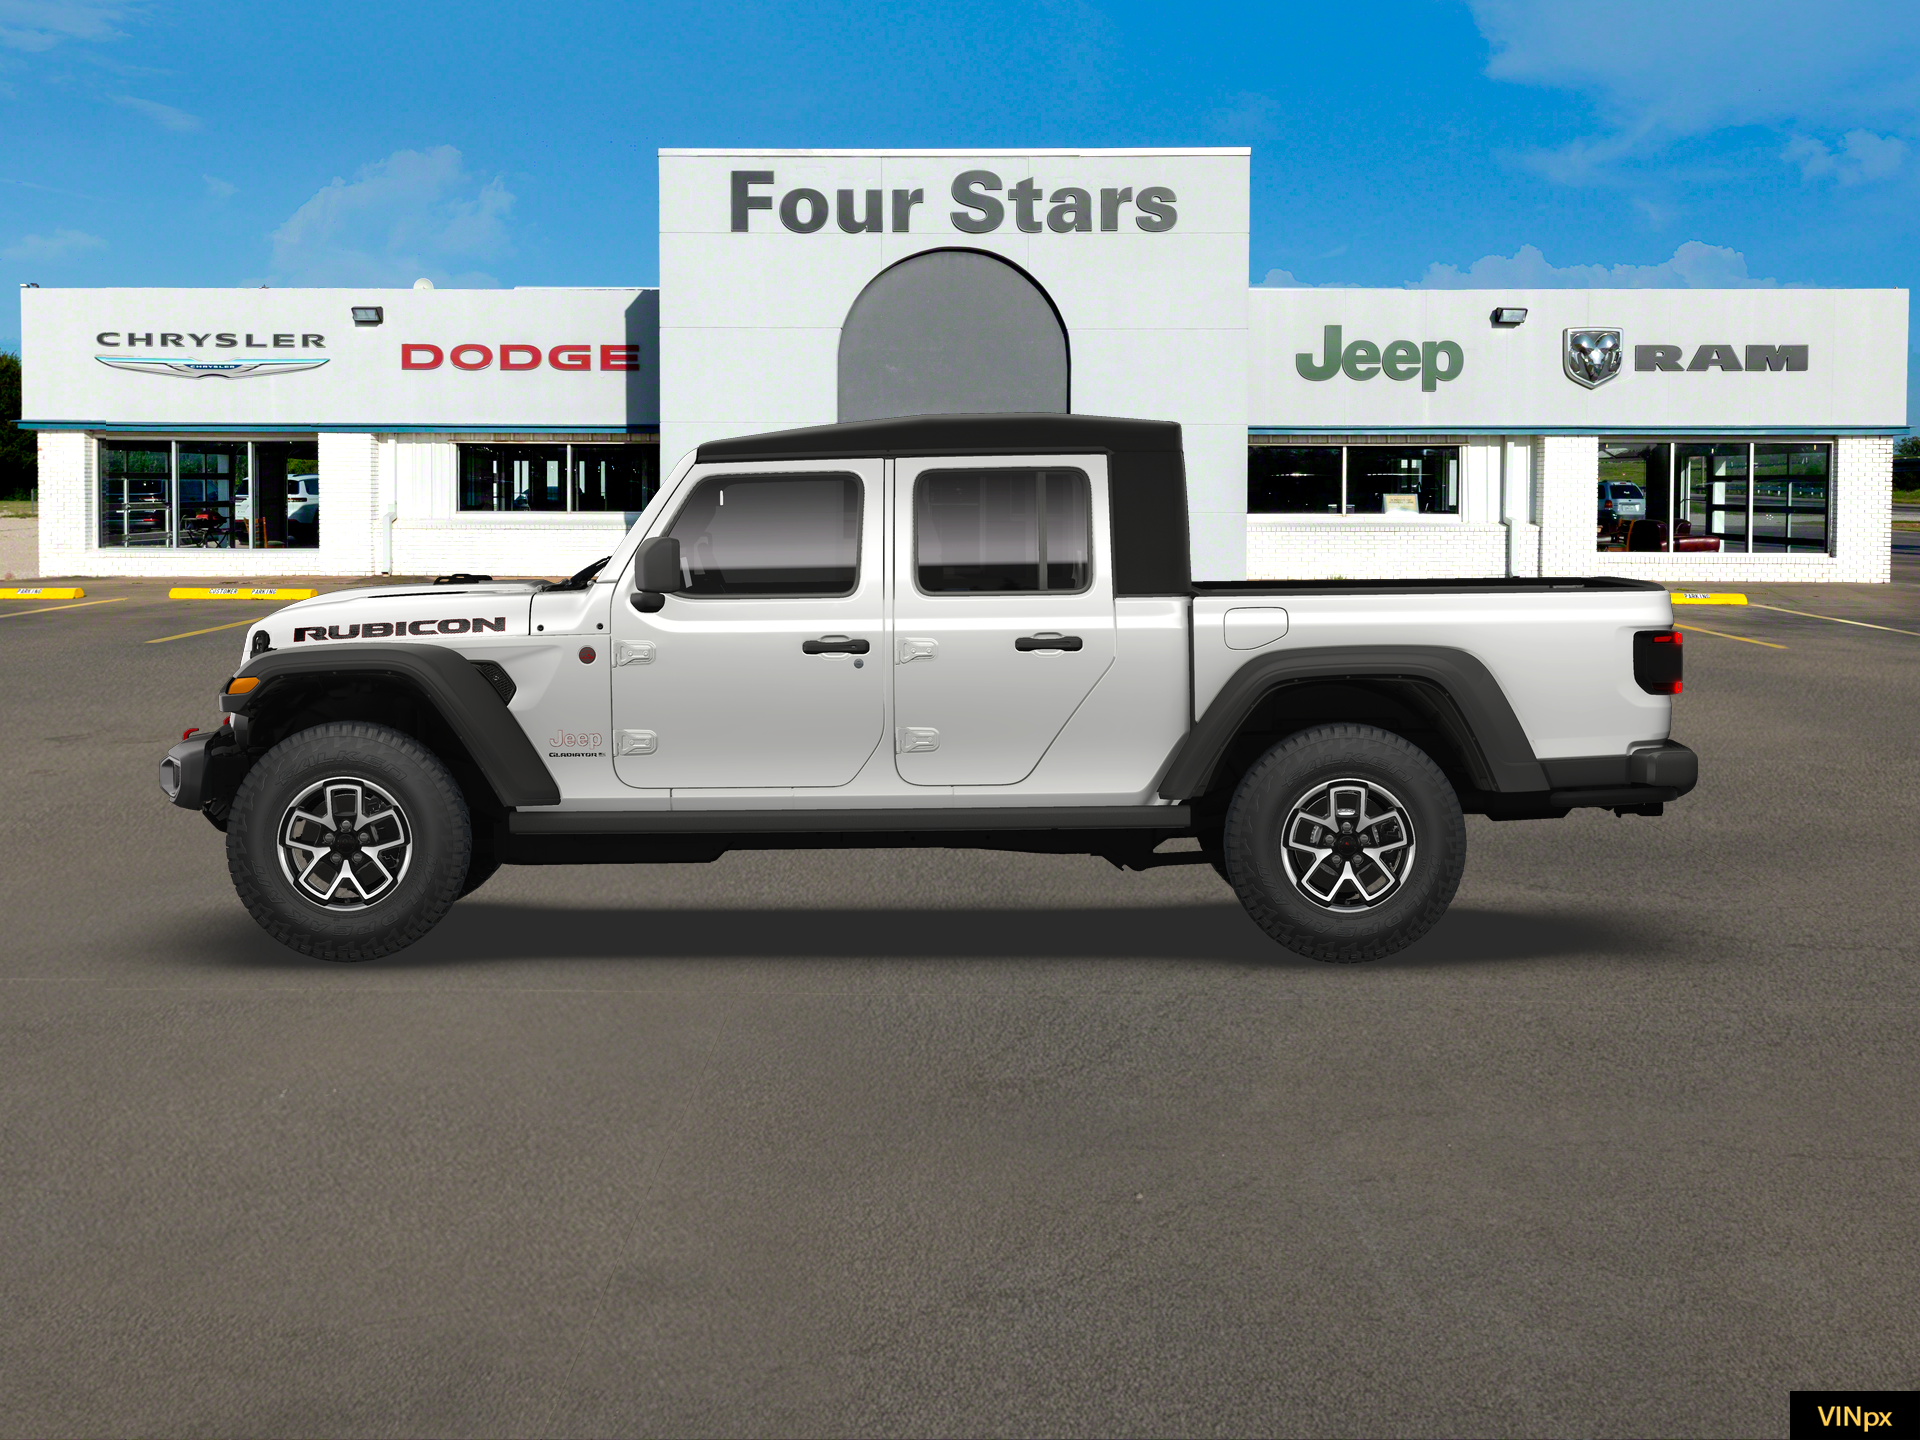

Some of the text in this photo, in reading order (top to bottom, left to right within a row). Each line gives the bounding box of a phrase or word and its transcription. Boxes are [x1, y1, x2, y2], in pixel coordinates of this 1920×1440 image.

[730, 169, 1178, 234] Four Stars
[96, 332, 326, 348] CHRYSLER
[401, 343, 640, 371] DODGE
[1296, 325, 1464, 392] Jeep
[1634, 344, 1809, 372] RAM
[293, 616, 506, 642] RUBICON
[549, 729, 603, 750] Jeep
[275, 750, 407, 787] FALKEN
[1281, 752, 1414, 788] FALKEN
